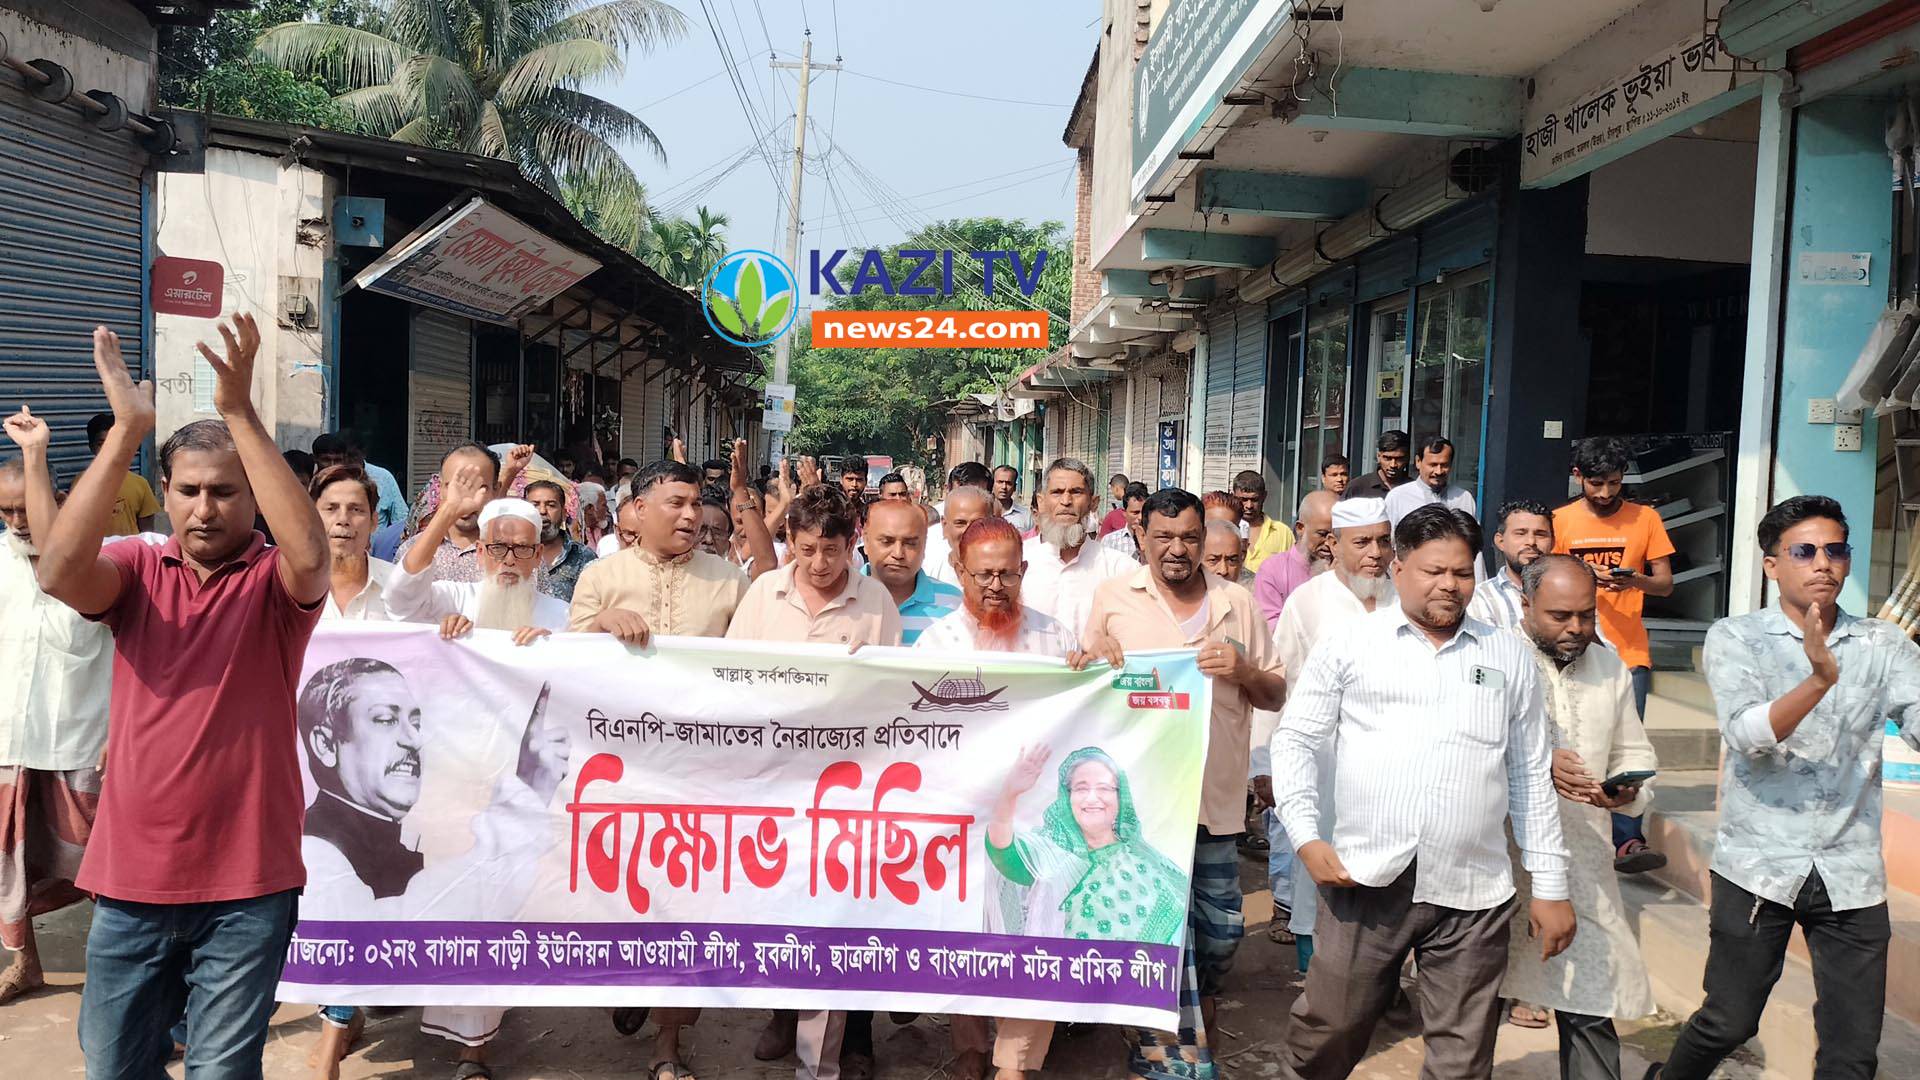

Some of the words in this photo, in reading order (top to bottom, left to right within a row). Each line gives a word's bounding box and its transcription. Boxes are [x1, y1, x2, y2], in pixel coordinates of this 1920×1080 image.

[1525, 113, 1560, 158] হাজী
[1563, 87, 1619, 137] খালেক
[1680, 36, 1717, 72] ভব
[164, 288, 213, 302] এয়ারটেল
[158, 373, 194, 395] বতী
[757, 667, 830, 687] সর্বশক্তিমান
[586, 708, 766, 748] বিএনপি-জামাতের
[771, 716, 868, 751] নৈরাজ্যের
[873, 717, 964, 751] প্রতিবাদে
[566, 752, 795, 915] বিক্ষোভ
[806, 760, 975, 906] মিছিল
[364, 939, 418, 969] ০২নং
[424, 935, 481, 968] বাগান
[486, 928, 531, 971] বাড়ী
[535, 930, 612, 969] ইউনিয়ন
[618, 929, 697, 968] আওয়ামী
[703, 930, 745, 975] লীগ,
[752, 932, 821, 977] যুবলীগ,
[828, 935, 899, 974] ছাত্রলীগ
[906, 947, 921, 972] ও
[928, 945, 1016, 978] বাংলাদেশ
[1021, 945, 1063, 982] মটর
[1069, 948, 1124, 985] শ্রমিক
